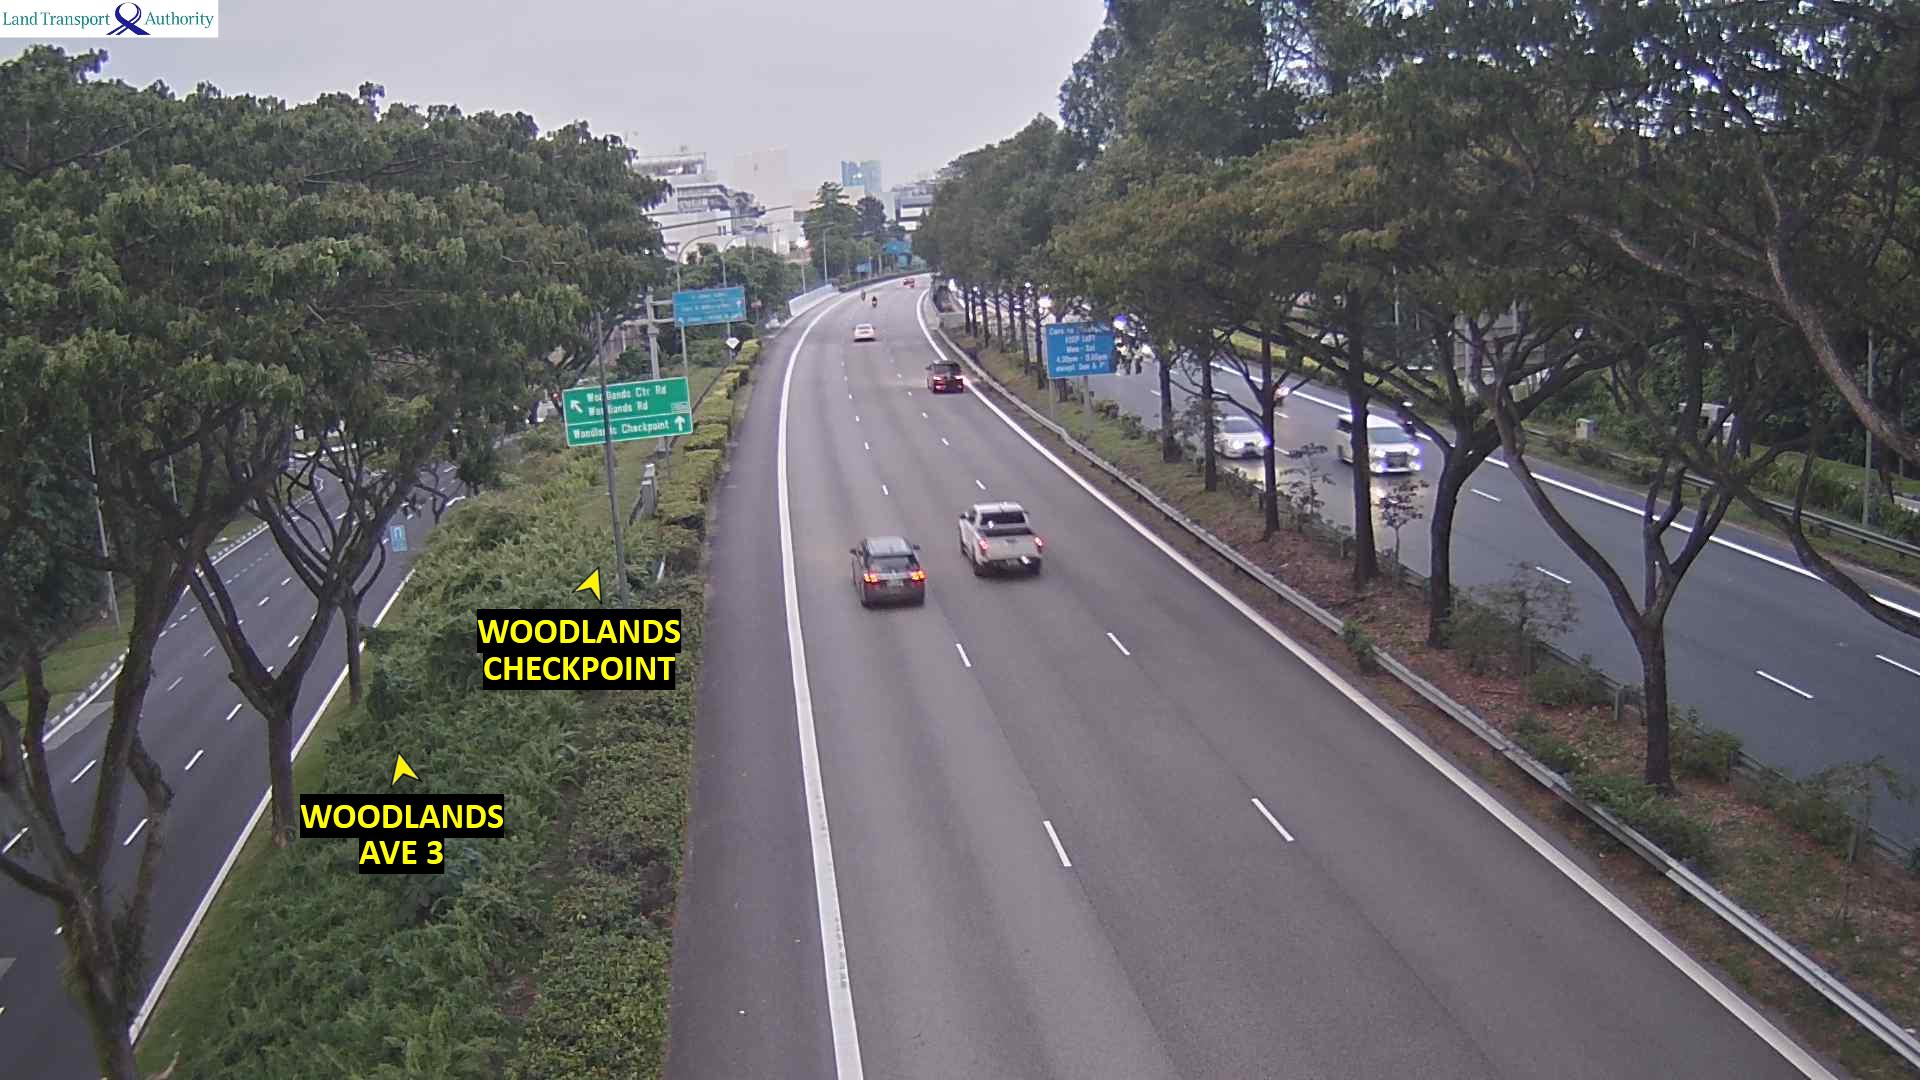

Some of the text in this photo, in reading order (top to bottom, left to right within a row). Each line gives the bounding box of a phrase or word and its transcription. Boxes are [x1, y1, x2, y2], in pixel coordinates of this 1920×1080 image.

[635, 387, 650, 398] Ctr
[656, 385, 667, 395] Rd
[637, 400, 648, 411] Rd
[622, 420, 670, 434] Checkpoint
